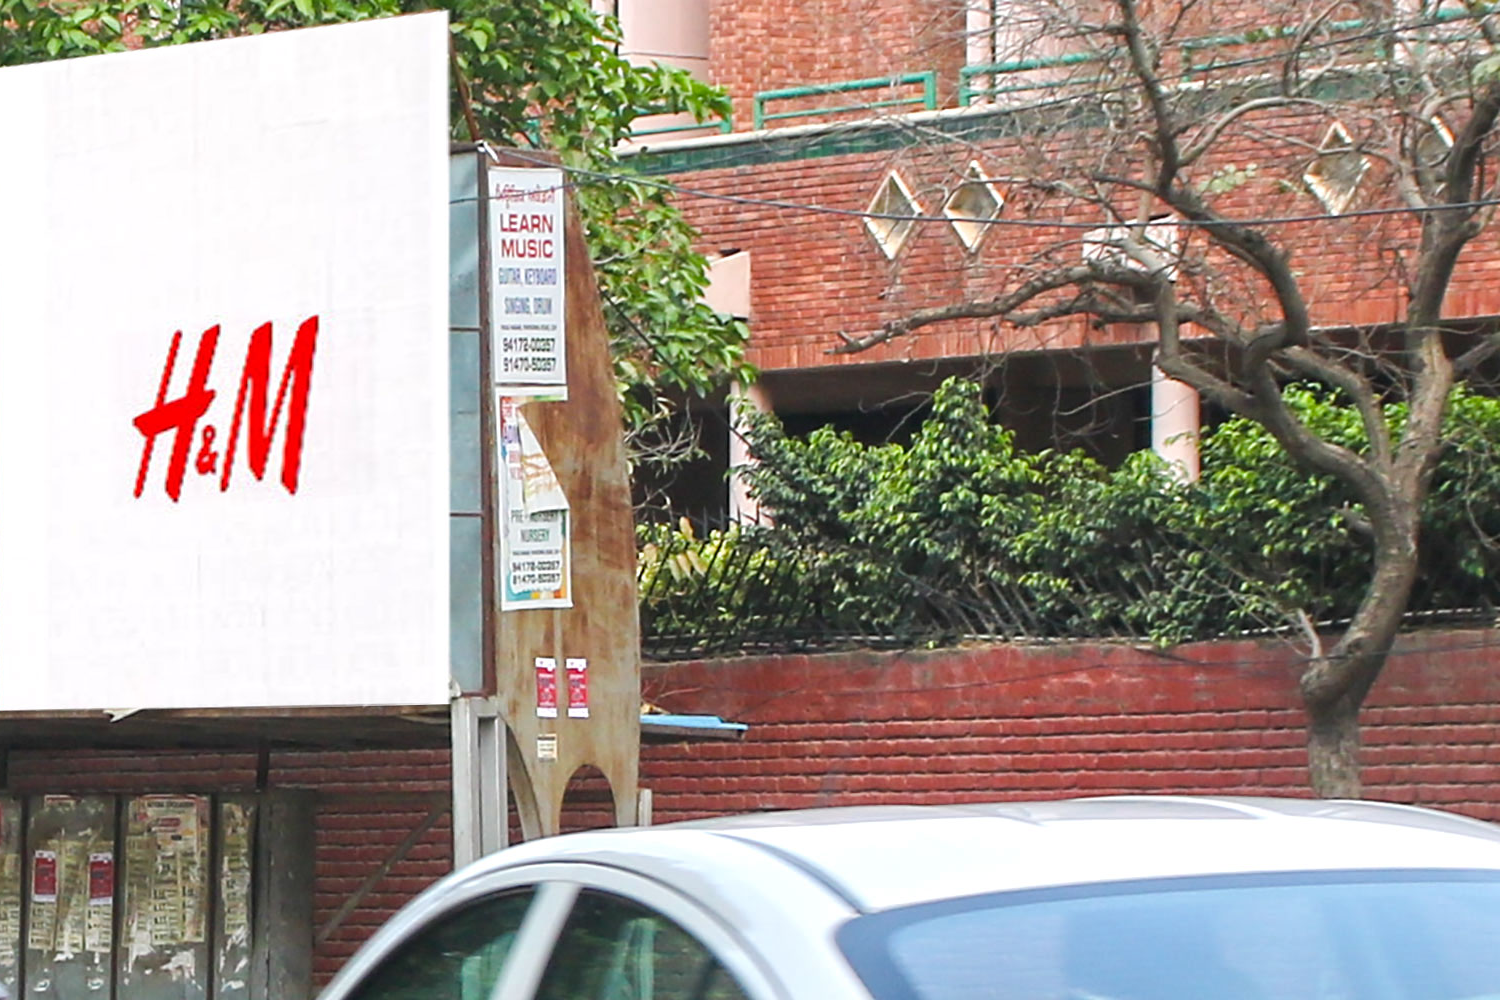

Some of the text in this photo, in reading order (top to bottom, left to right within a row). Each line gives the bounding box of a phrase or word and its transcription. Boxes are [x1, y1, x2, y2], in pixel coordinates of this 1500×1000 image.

[500, 214, 553, 233] LEARN
[501, 239, 553, 258] MUSIC
[133, 314, 319, 502] H&M
